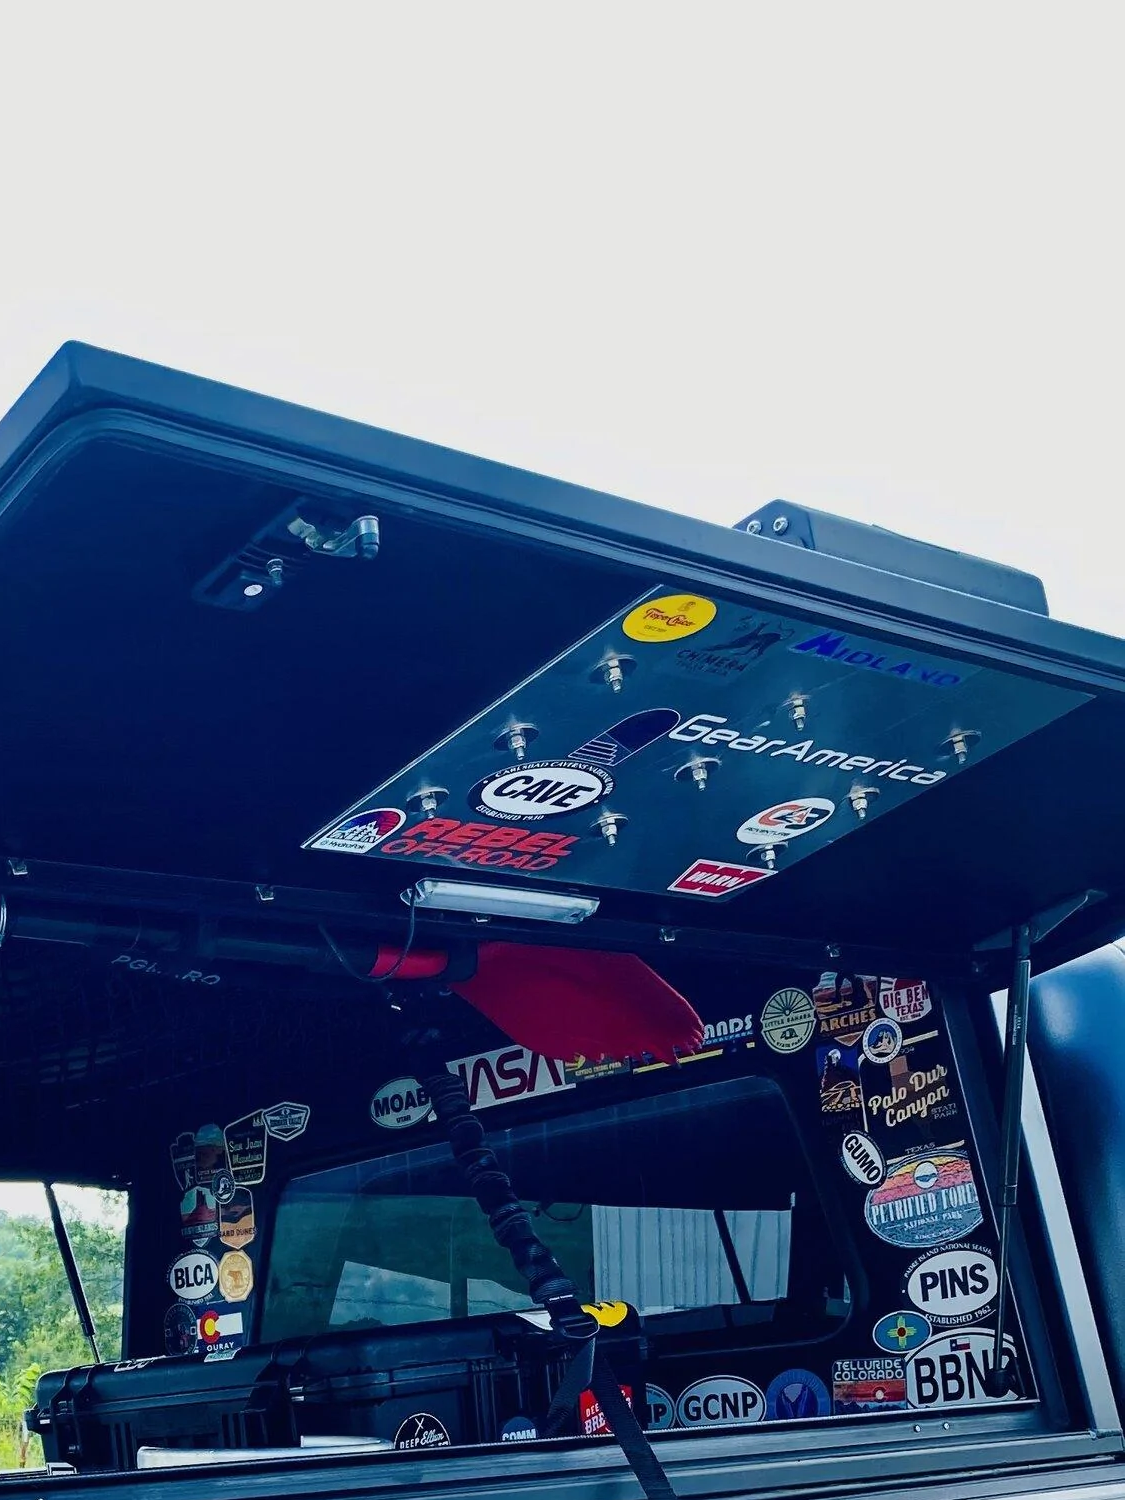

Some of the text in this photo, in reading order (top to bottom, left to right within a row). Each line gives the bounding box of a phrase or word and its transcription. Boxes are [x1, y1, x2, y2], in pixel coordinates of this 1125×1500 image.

[669, 714, 947, 785] GearAmerica
[493, 775, 596, 808] CAVE
[401, 817, 580, 857] REBEL
[380, 838, 561, 871] OFF ROAD
[684, 871, 746, 888] WARN
[882, 993, 902, 1009] BIG
[895, 1002, 924, 1017] TEXAS
[704, 1014, 753, 1039] ANDS
[764, 1013, 812, 1028] LITTLE SAHARA
[820, 1008, 876, 1033] ARCHES
[868, 1064, 948, 1116] Palo Dur
[886, 1085, 950, 1128] Canyon
[933, 1110, 958, 1120] PARK
[845, 1136, 881, 1182] GUMO
[905, 1142, 936, 1154] TEXAS
[870, 1182, 977, 1225] PETRIFIED FORE
[903, 1260, 919, 1279] PADRE
[918, 1248, 939, 1263] ISLAND
[940, 1242, 971, 1251] NATIONAL
[174, 1262, 215, 1290] BLCA
[919, 1263, 989, 1302] PINS
[924, 1305, 992, 1325] ESTABLISHED 1962
[206, 1341, 235, 1352] OURAY
[834, 1369, 904, 1381] COLORADO
[836, 1359, 902, 1371] TELLURIDE
[683, 1391, 758, 1421] GCNP
[400, 1437, 419, 1449] DEEP
